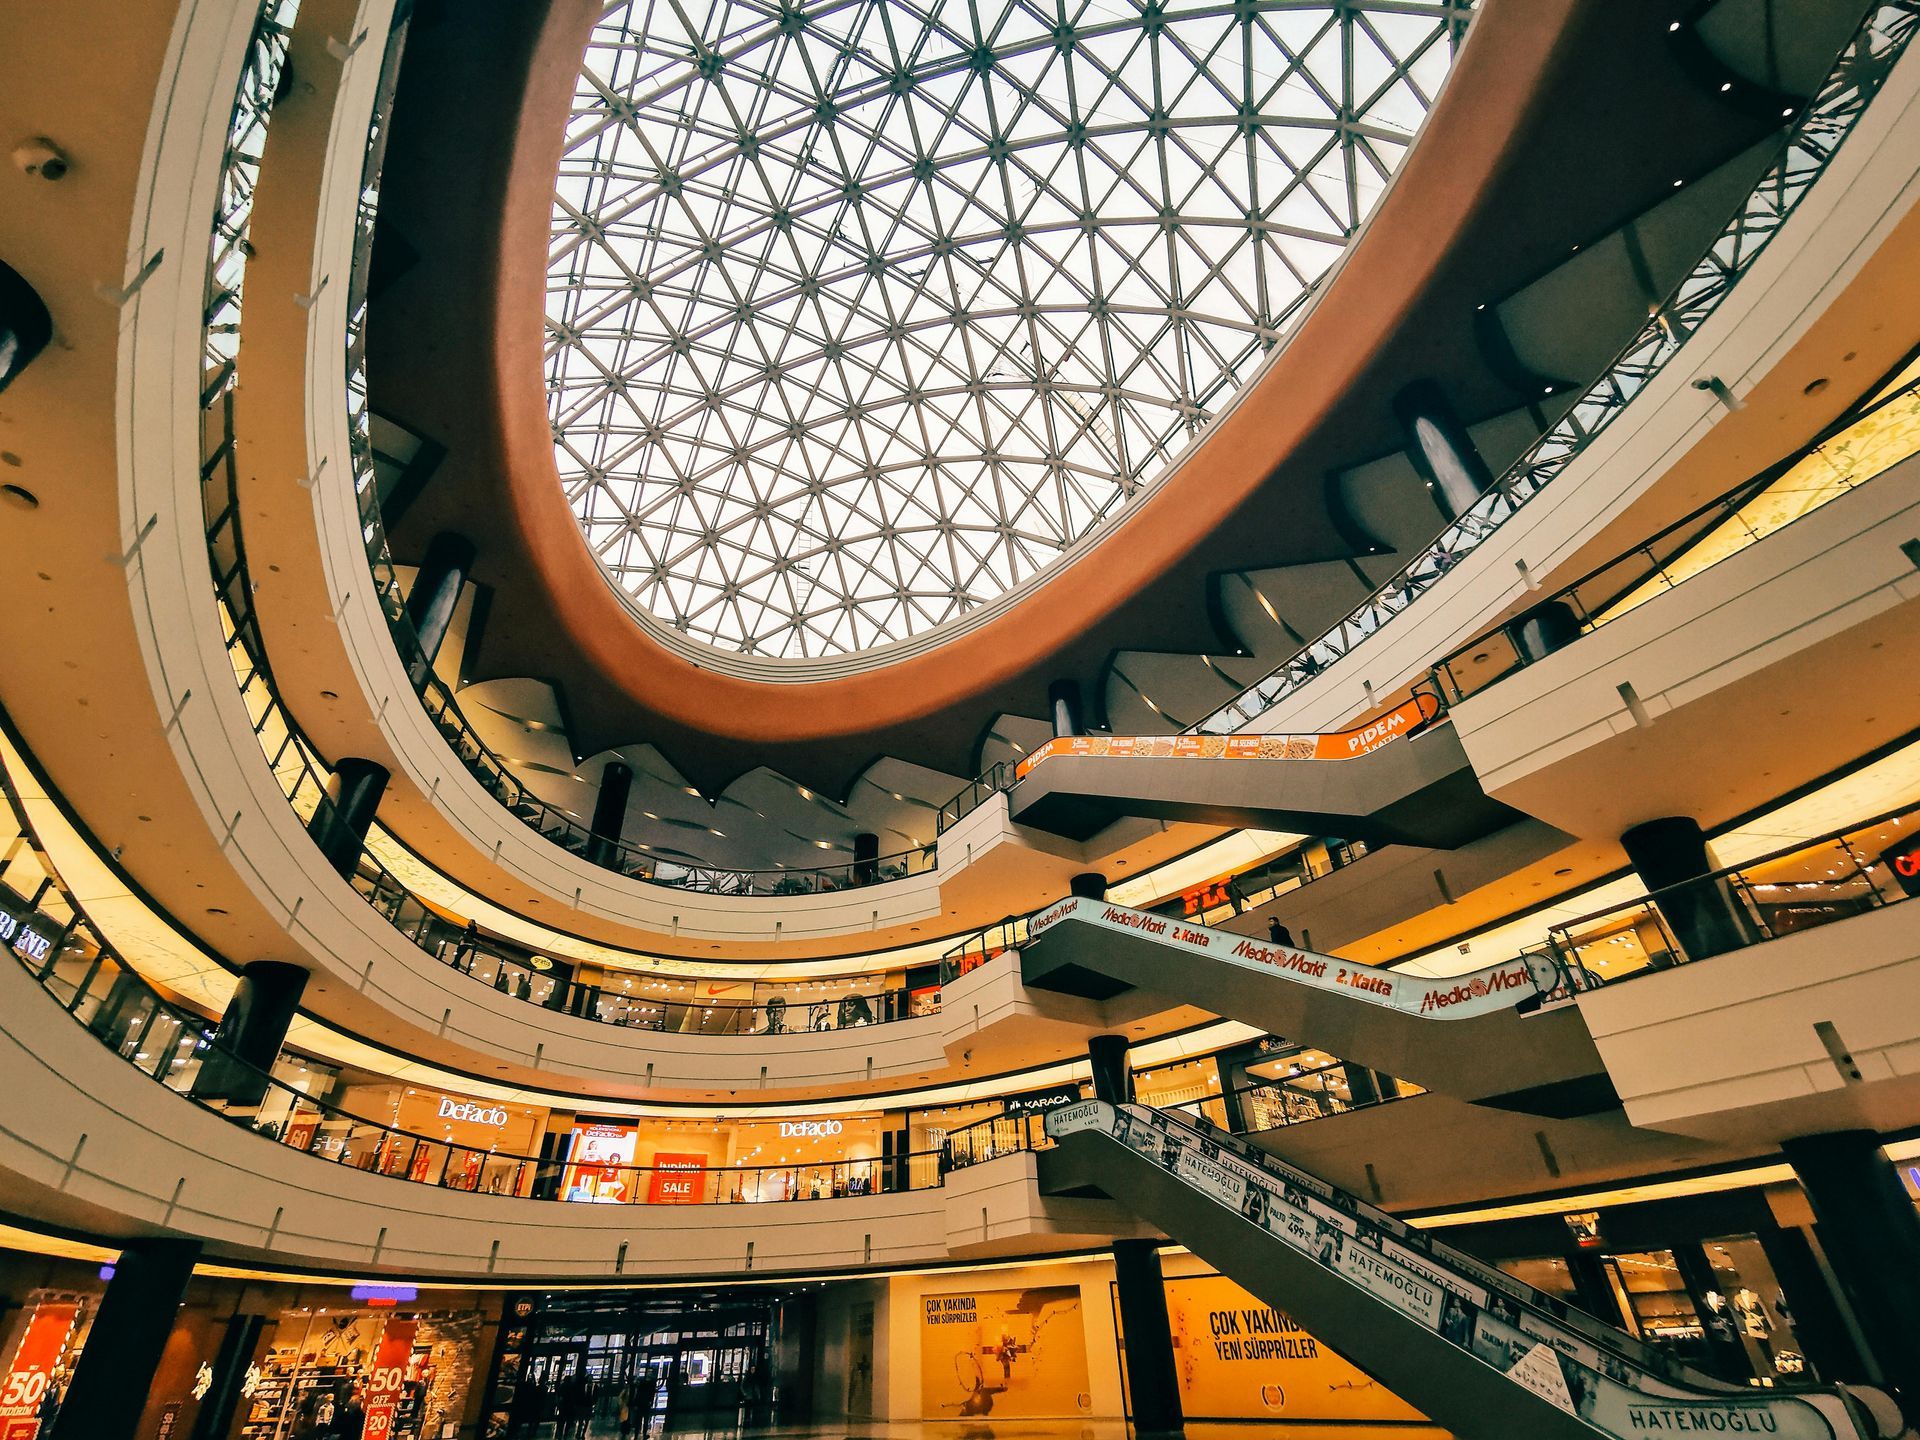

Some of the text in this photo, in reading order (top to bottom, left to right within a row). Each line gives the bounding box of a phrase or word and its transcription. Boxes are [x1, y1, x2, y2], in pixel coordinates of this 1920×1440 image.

[1348, 714, 1406, 752] PIDEM
[1350, 972, 1393, 996] Katta
[438, 1098, 508, 1126] DeFacto
[1024, 1095, 1071, 1109] KARACA
[1053, 1105, 1099, 1126] HATEMOĞLU
[779, 1119, 843, 1138] DeFacto
[663, 1182, 691, 1194] SALE
[1349, 1249, 1433, 1307] HATEMOĞLU
[926, 1297, 977, 1314] ÇOK YAKINDA
[926, 1312, 978, 1325] YENİ SÜRPRİZLER
[1209, 1309, 1305, 1340] ÇOK YAKIND
[1214, 1336, 1319, 1361] YENİ SÜRPRİZLER
[2, 1371, 46, 1405] 50
[370, 1367, 402, 1392] 50
[372, 1394, 391, 1405] OFF
[368, 1415, 388, 1431] 20
[1629, 1406, 1777, 1433] HATEMOĞLU
